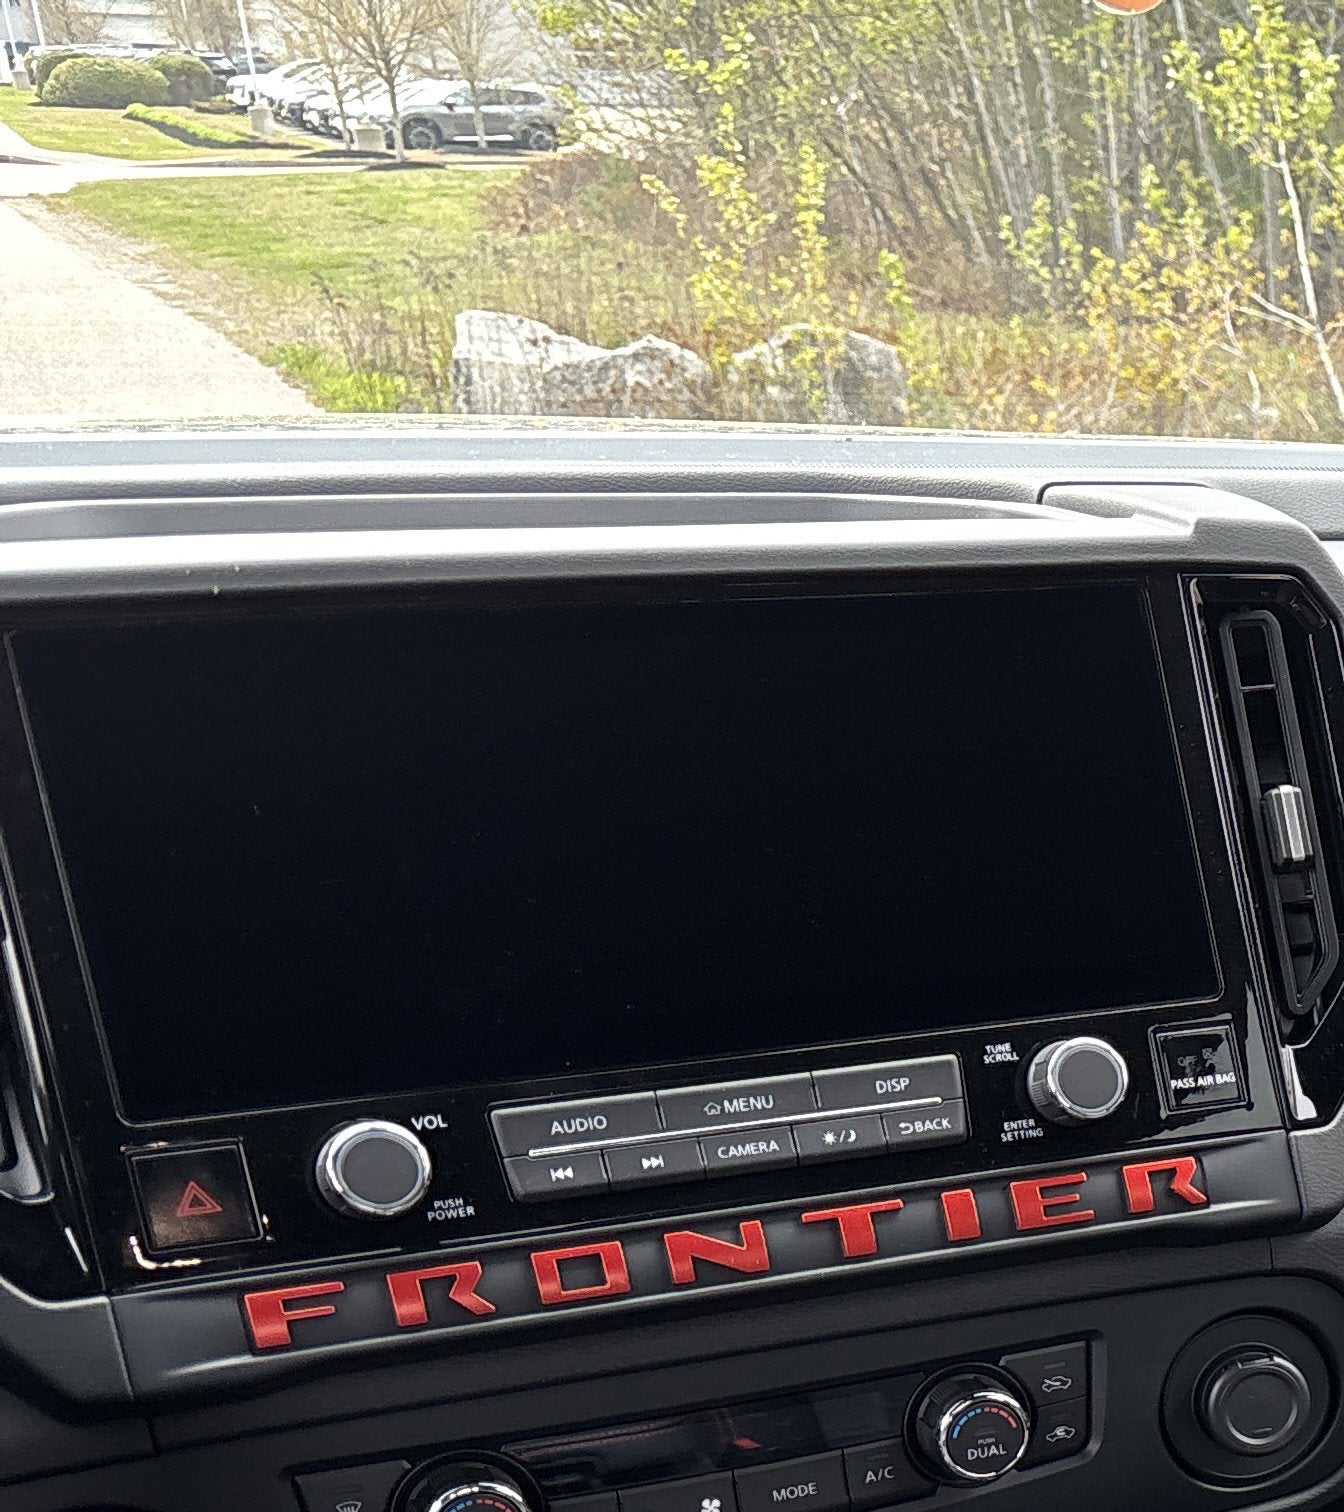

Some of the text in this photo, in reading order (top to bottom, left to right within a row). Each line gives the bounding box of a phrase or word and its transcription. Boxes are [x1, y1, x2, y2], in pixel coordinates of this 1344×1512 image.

[984, 1042, 1012, 1055] TUNE
[983, 1051, 1020, 1064] SCROLL
[875, 1078, 911, 1094] DISP
[1170, 1072, 1236, 1089] PASS AIR BAG
[724, 1095, 774, 1114] MENU
[411, 1113, 448, 1131] VOL
[551, 1115, 608, 1135] AUDIO
[914, 1117, 951, 1133] BACK
[1003, 1118, 1036, 1131] ENTER
[1001, 1127, 1044, 1142] SETTING
[717, 1139, 780, 1159] CAMERA
[434, 1197, 464, 1209] PUSH
[427, 1205, 475, 1222] POWER
[244, 1156, 1207, 1349] FRONTIER
[967, 1444, 1008, 1461] DUAL
[865, 1465, 894, 1484] A/C
[772, 1481, 818, 1502] MODE
